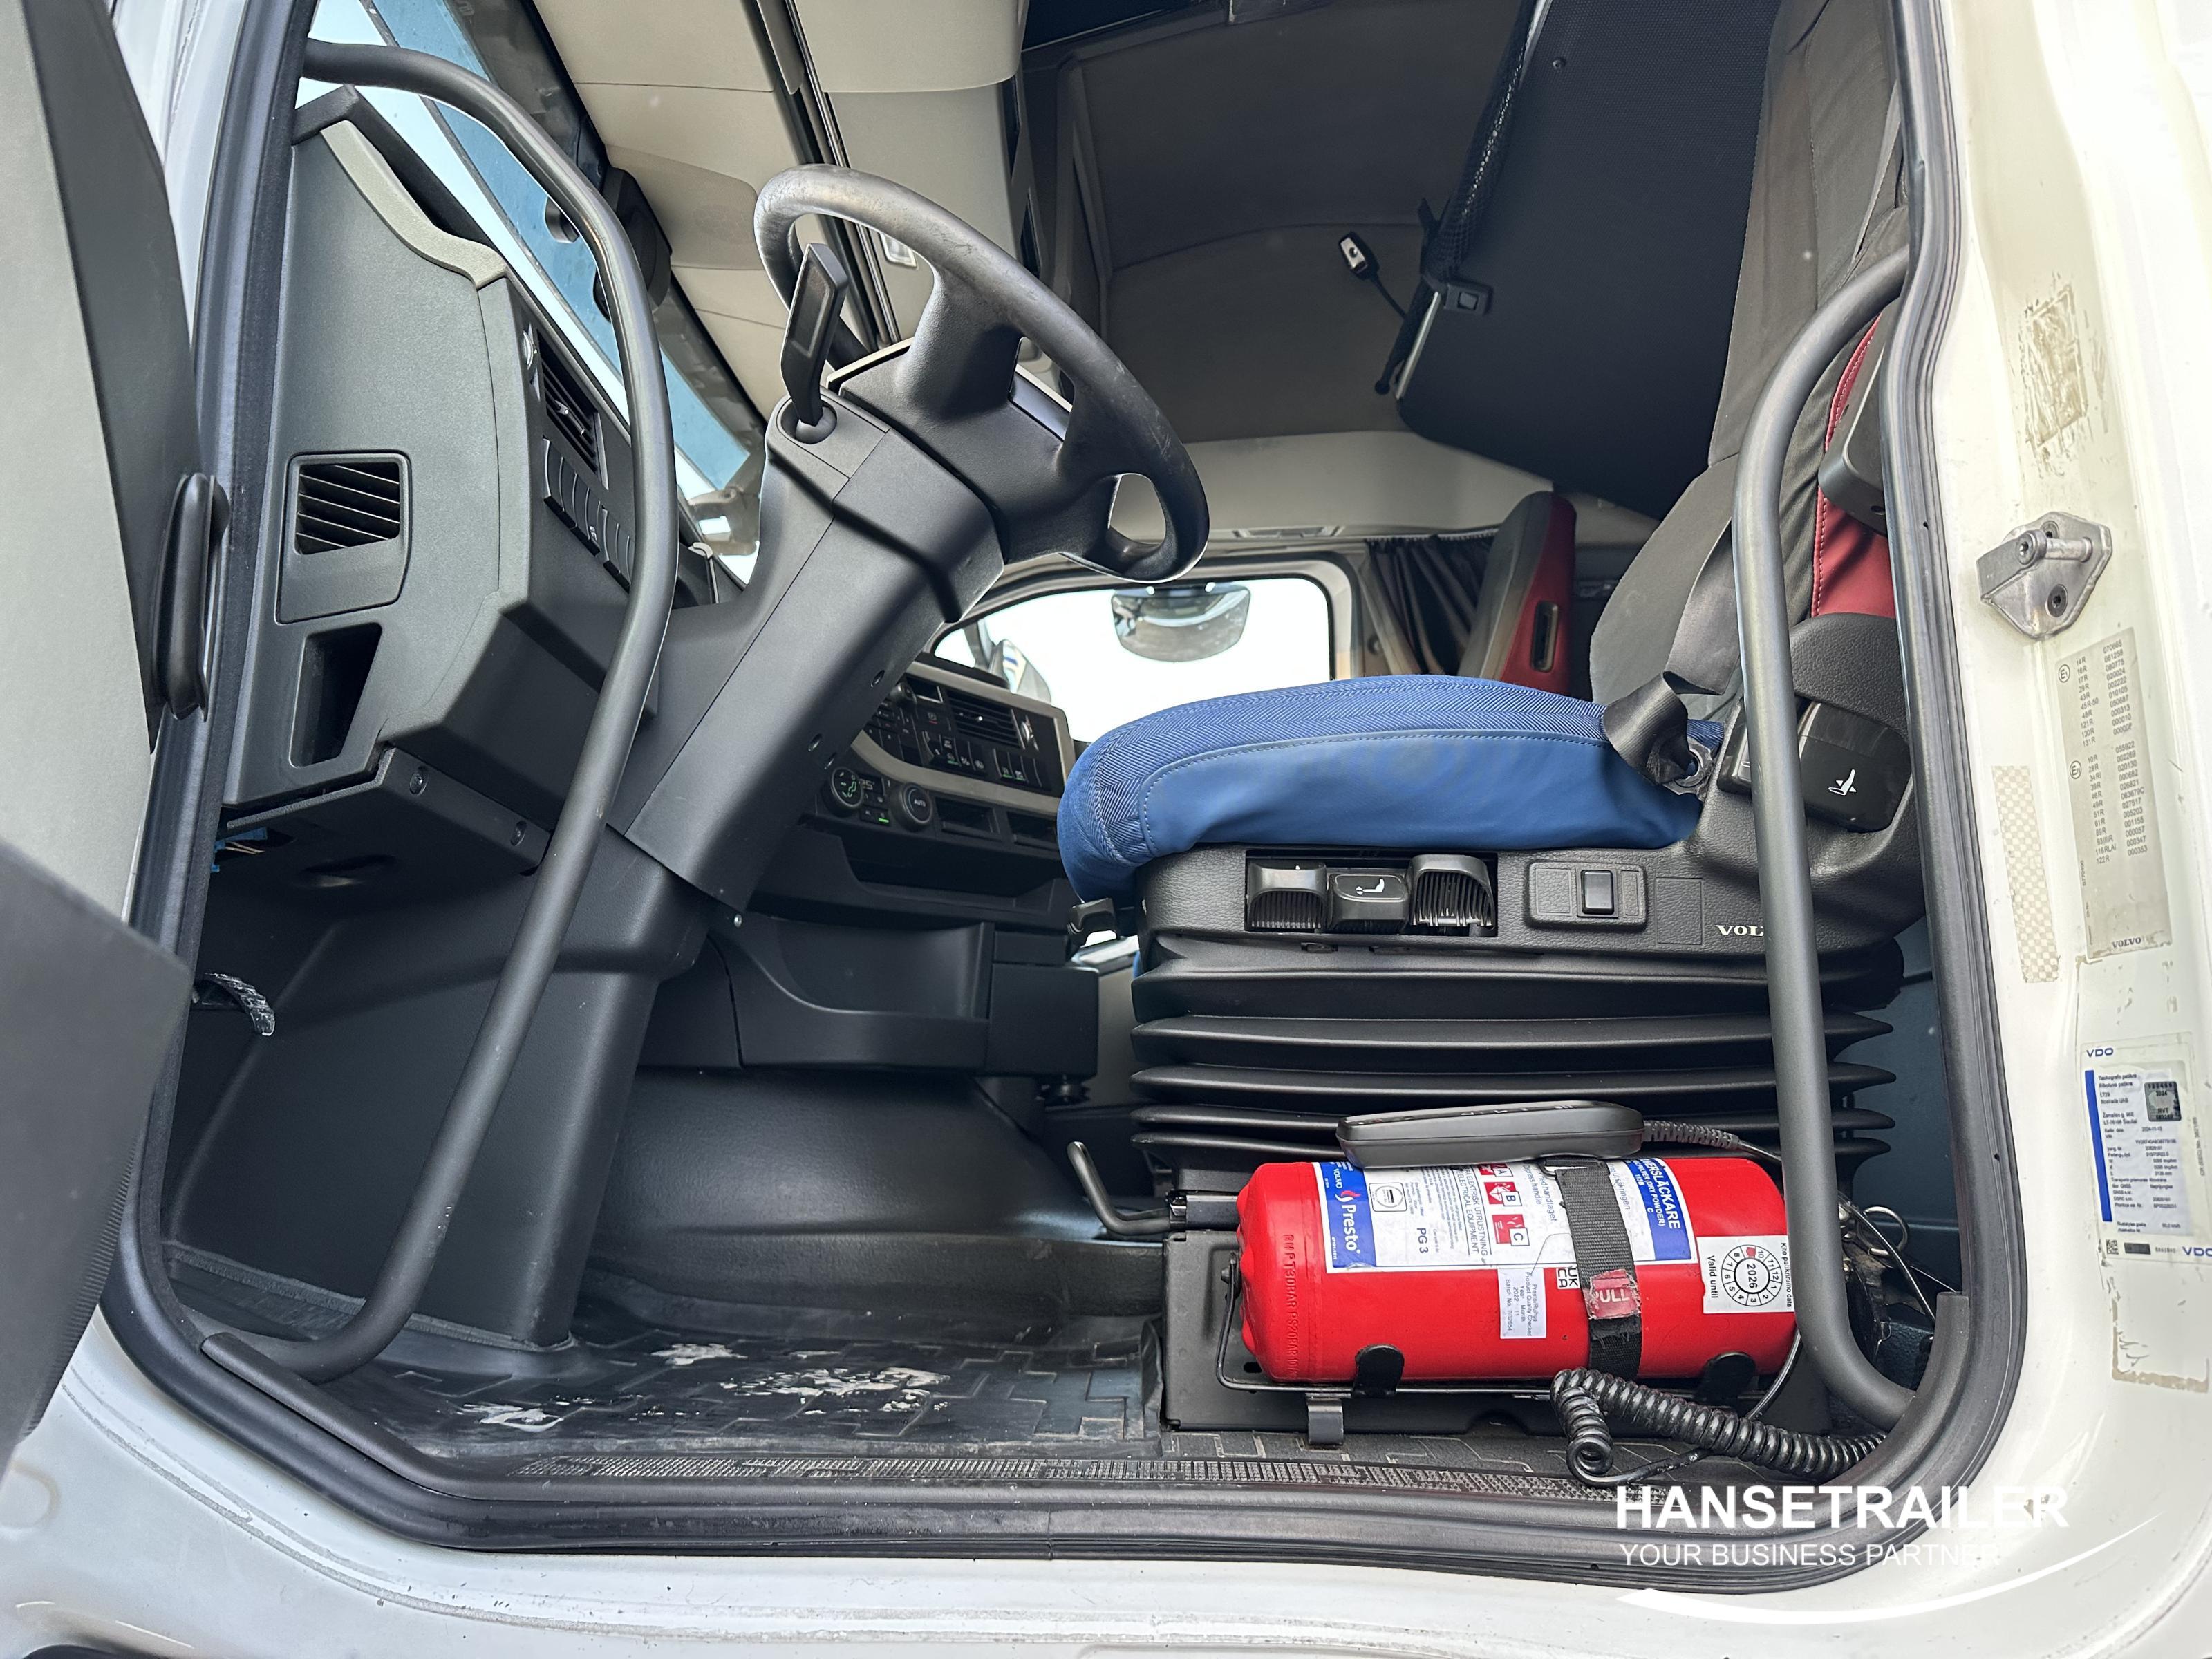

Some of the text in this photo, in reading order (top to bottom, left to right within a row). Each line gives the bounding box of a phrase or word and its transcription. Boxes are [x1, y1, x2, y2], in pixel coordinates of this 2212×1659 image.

[2076, 657, 2086, 665] 14R
[2078, 674, 2088, 684] 17R
[2080, 692, 2090, 701] 43R
[2109, 686, 2128, 699] 010105
[2081, 704, 2130, 729] 121R 000313
[2082, 728, 2094, 738] 130R
[2083, 737, 2096, 747] 131R
[2088, 754, 2098, 763] 10R
[2127, 835, 2146, 846] 000347
[2097, 855, 2110, 864] 122R
[1716, 925, 1763, 936] VOL
[2112, 937, 2141, 948] VOLVO
[2086, 1047, 2114, 1058] VDO
[1333, 1169, 1342, 1188] VOLVO
[1634, 1174, 1644, 1185] 113B
[1531, 1183, 1543, 1205] handle
[1644, 1180, 1656, 1193] (DRY
[1651, 1194, 1665, 1226] POWDER)
[1456, 1174, 1470, 1207] ELECTRICAL
[1466, 1210, 1479, 1253] EQUIPMENT
[1467, 1176, 1480, 1205] ELEKTRISK
[1474, 1207, 1488, 1256] UTRUSTNING
[1342, 1204, 1358, 1251] Presto
[1416, 1228, 1428, 1244] PG
[1513, 1232, 1524, 1241] C
[1758, 1250, 1764, 1259] 10
[1768, 1259, 1775, 1267] 11
[1772, 1271, 1779, 1280] 12
[1558, 1268, 1568, 1288] CA
[1568, 1268, 1579, 1287] UK
[1707, 1255, 1718, 1298] Valid until
[1747, 1264, 1758, 1288] 2026
